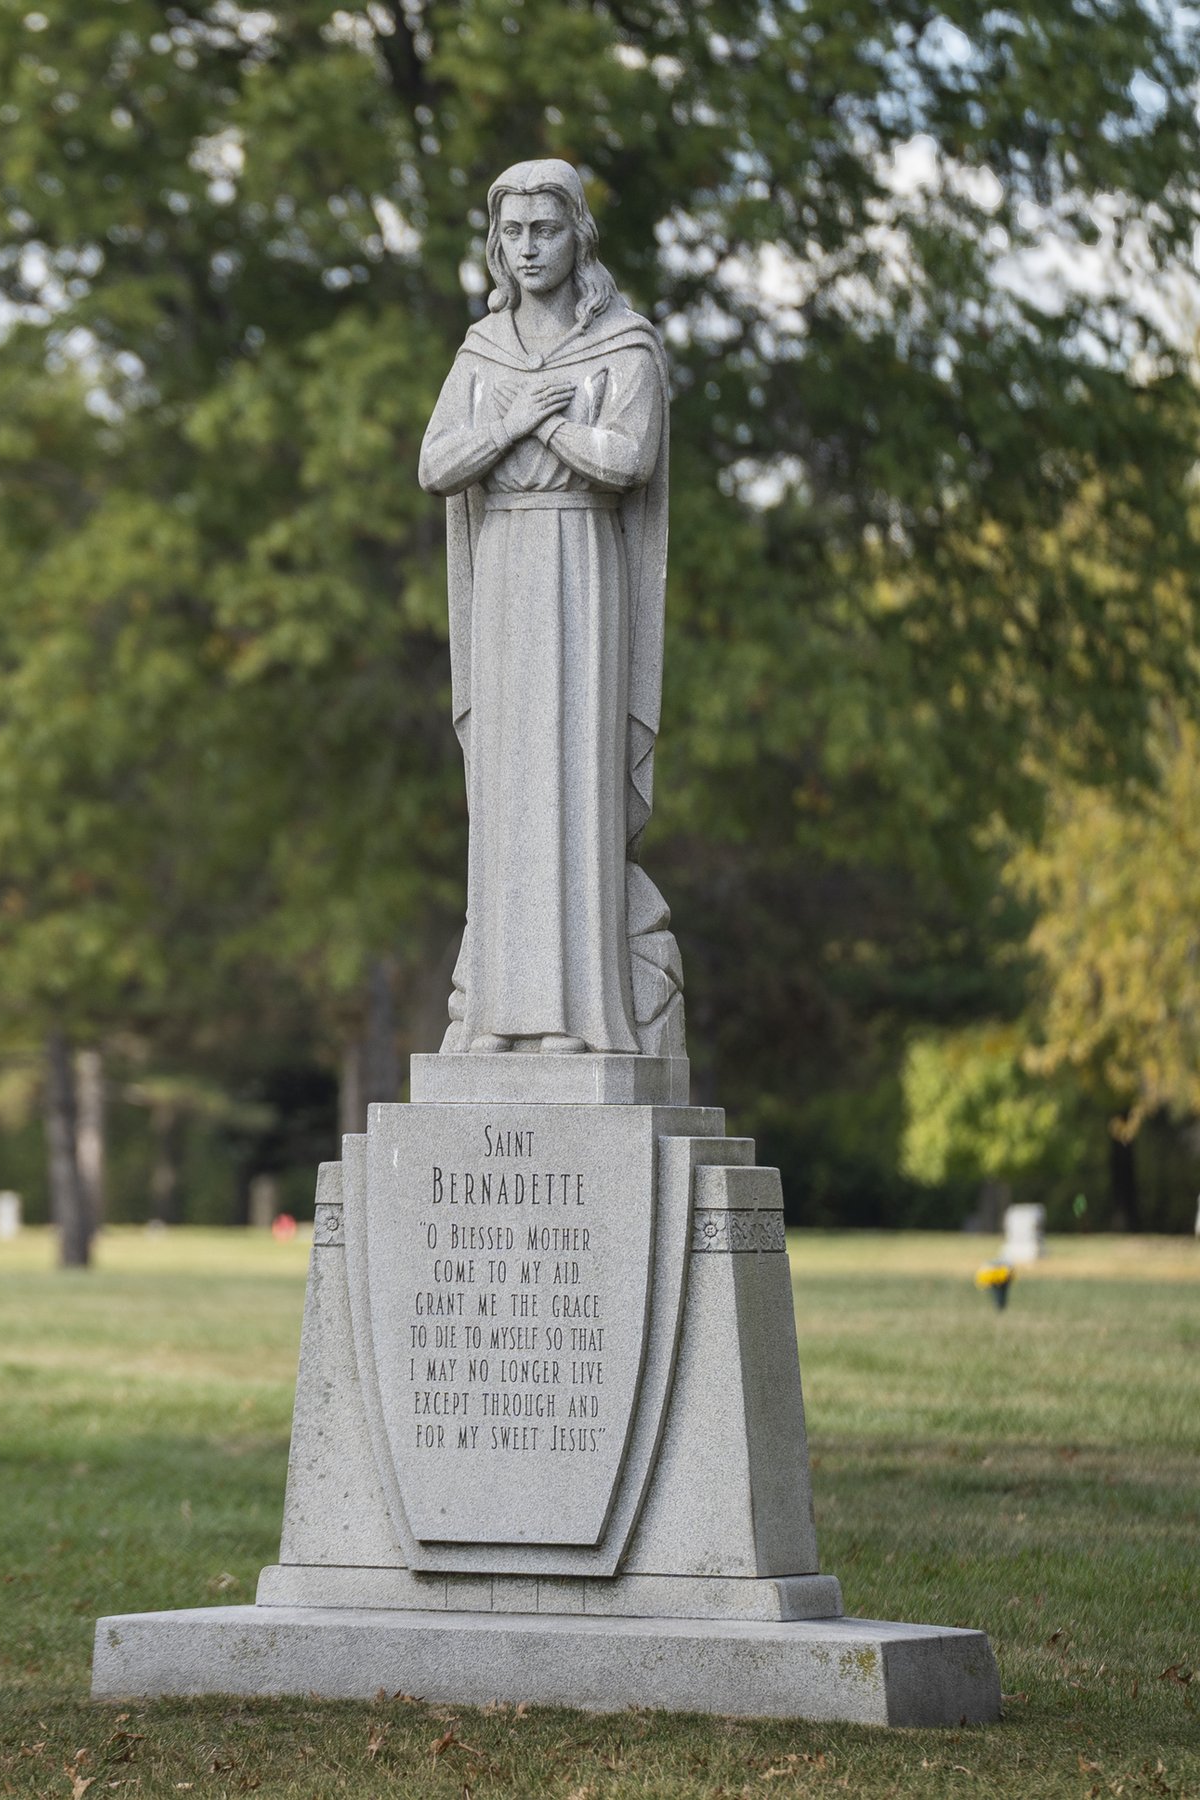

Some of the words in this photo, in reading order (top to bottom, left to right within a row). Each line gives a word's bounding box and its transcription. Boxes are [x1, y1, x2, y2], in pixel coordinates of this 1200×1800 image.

[484, 1124, 534, 1157] SAINT
[432, 1167, 584, 1205] BERNADETTE
[452, 1224, 513, 1250] BLESSED
[527, 1225, 590, 1250] MOTHER
[434, 1260, 474, 1283] COME
[489, 1261, 506, 1283] TO
[521, 1262, 540, 1283] MY
[553, 1262, 581, 1284] AID.
[416, 1292, 464, 1315] GRANT
[478, 1294, 497, 1316] ME
[511, 1294, 538, 1316] THE
[552, 1295, 599, 1318] GRACE
[411, 1325, 426, 1348] TO
[436, 1326, 456, 1348] DIE
[465, 1326, 481, 1349] TO
[490, 1327, 538, 1350] MYSELF
[546, 1328, 562, 1350] SO
[571, 1328, 604, 1351] THAT
[410, 1358, 414, 1381] I
[427, 1359, 457, 1381] MAY
[469, 1360, 489, 1382] NO
[501, 1360, 560, 1383] LONGER
[572, 1362, 603, 1384] LIVE
[414, 1392, 469, 1415] EXCEPT
[483, 1393, 555, 1417] THROUGH
[569, 1395, 598, 1418] AND
[416, 1425, 445, 1448] FOR
[458, 1426, 478, 1449] MY
[491, 1426, 538, 1450] SWEET
